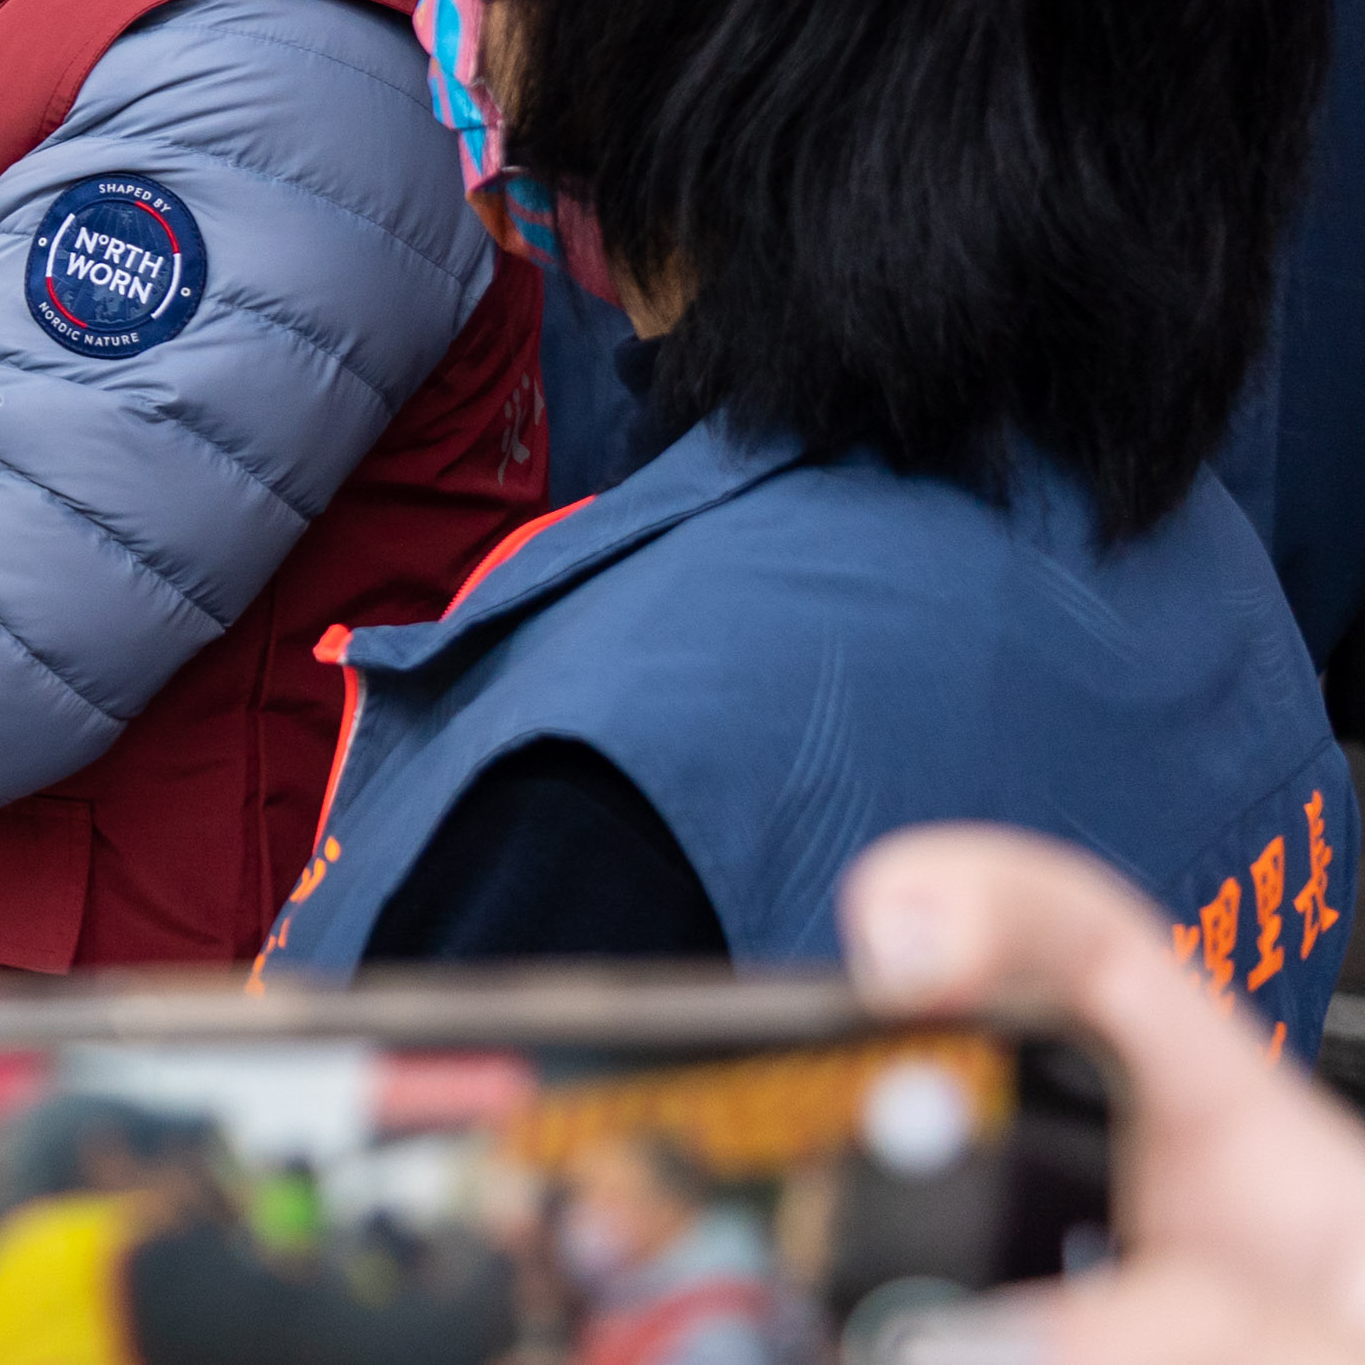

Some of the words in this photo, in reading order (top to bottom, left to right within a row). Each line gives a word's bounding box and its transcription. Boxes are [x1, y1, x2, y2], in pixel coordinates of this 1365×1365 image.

[99, 184, 152, 201] SHAPED
[153, 198, 172, 213] BY
[66, 252, 153, 304] WORN
[38, 301, 81, 341] NORDIC
[84, 332, 140, 347] NATURE
